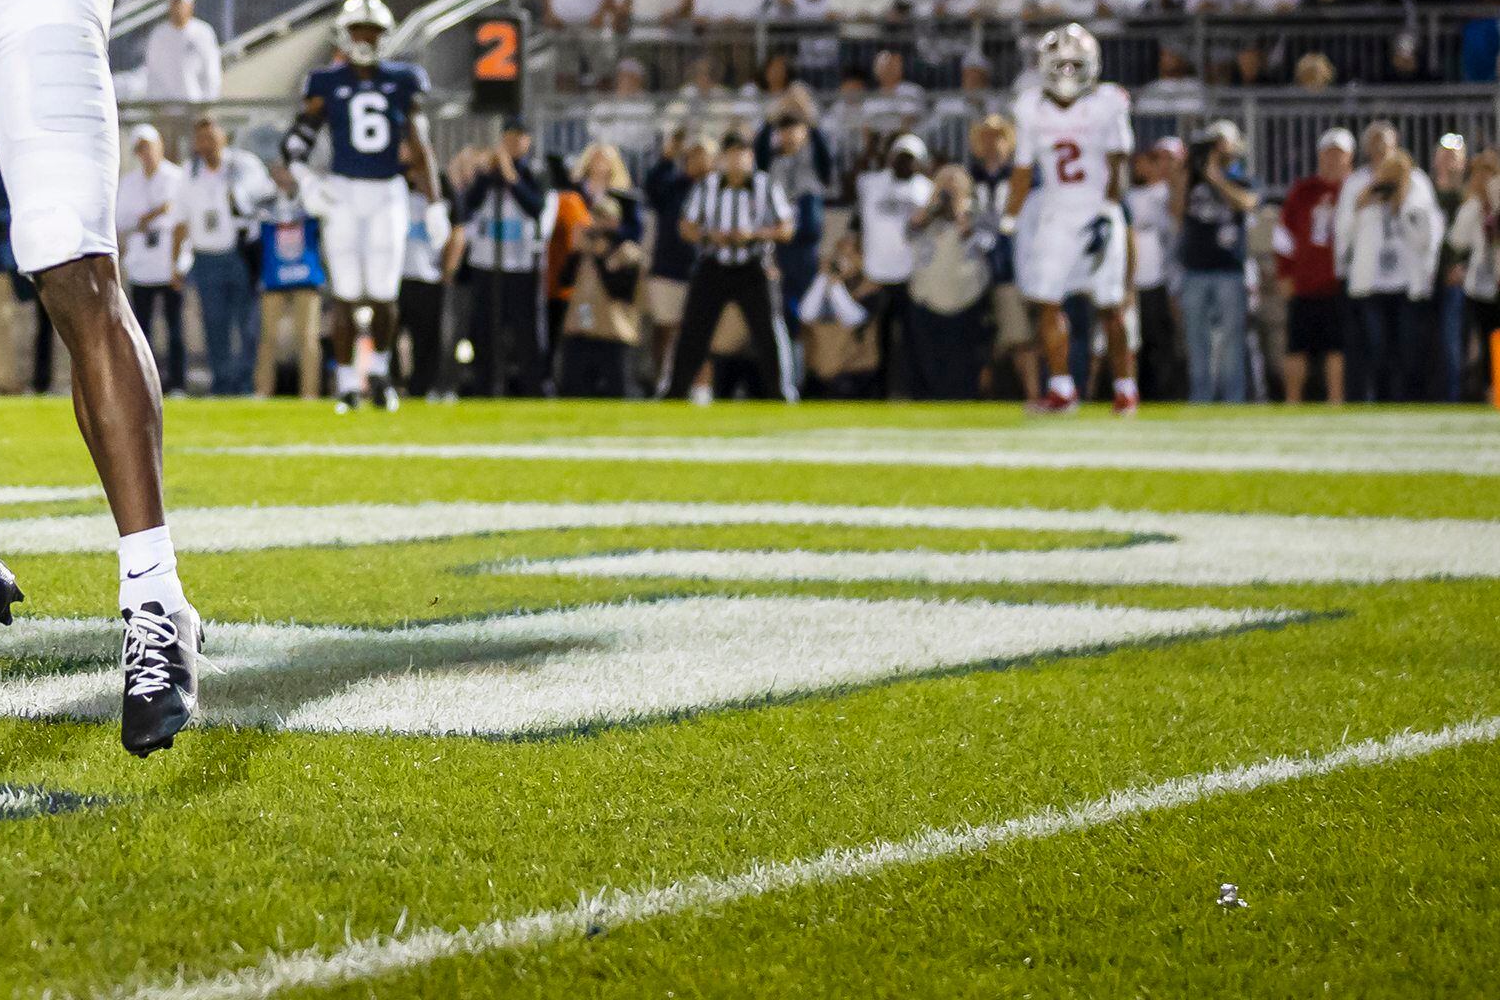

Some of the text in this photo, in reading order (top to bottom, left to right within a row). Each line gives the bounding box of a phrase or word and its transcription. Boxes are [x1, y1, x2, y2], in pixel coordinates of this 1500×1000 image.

[474, 22, 518, 81] 2
[348, 92, 391, 154] 6
[1051, 139, 1087, 184] 2
